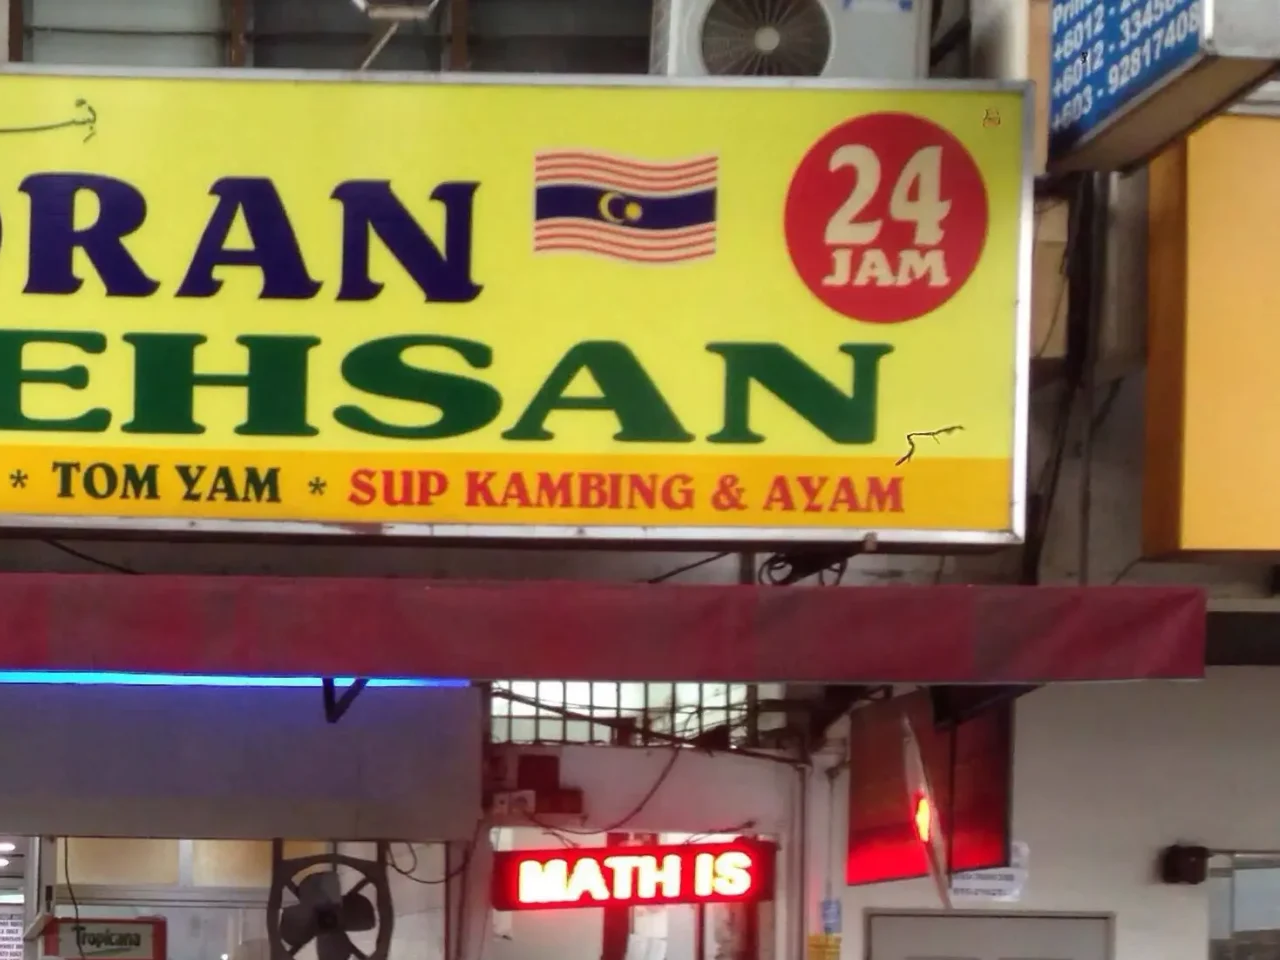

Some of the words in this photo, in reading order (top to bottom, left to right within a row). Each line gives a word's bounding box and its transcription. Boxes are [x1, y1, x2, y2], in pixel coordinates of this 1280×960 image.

[824, 145, 951, 247] 24
[822, 249, 950, 287] JAM
[51, 461, 162, 501] TOM
[174, 464, 283, 505] YAM
[347, 467, 450, 508] SUP
[464, 469, 696, 511] KAMBING
[710, 473, 749, 512] &
[762, 474, 905, 514] AYAM
[518, 855, 682, 902] MATH
[694, 851, 752, 897] IS
